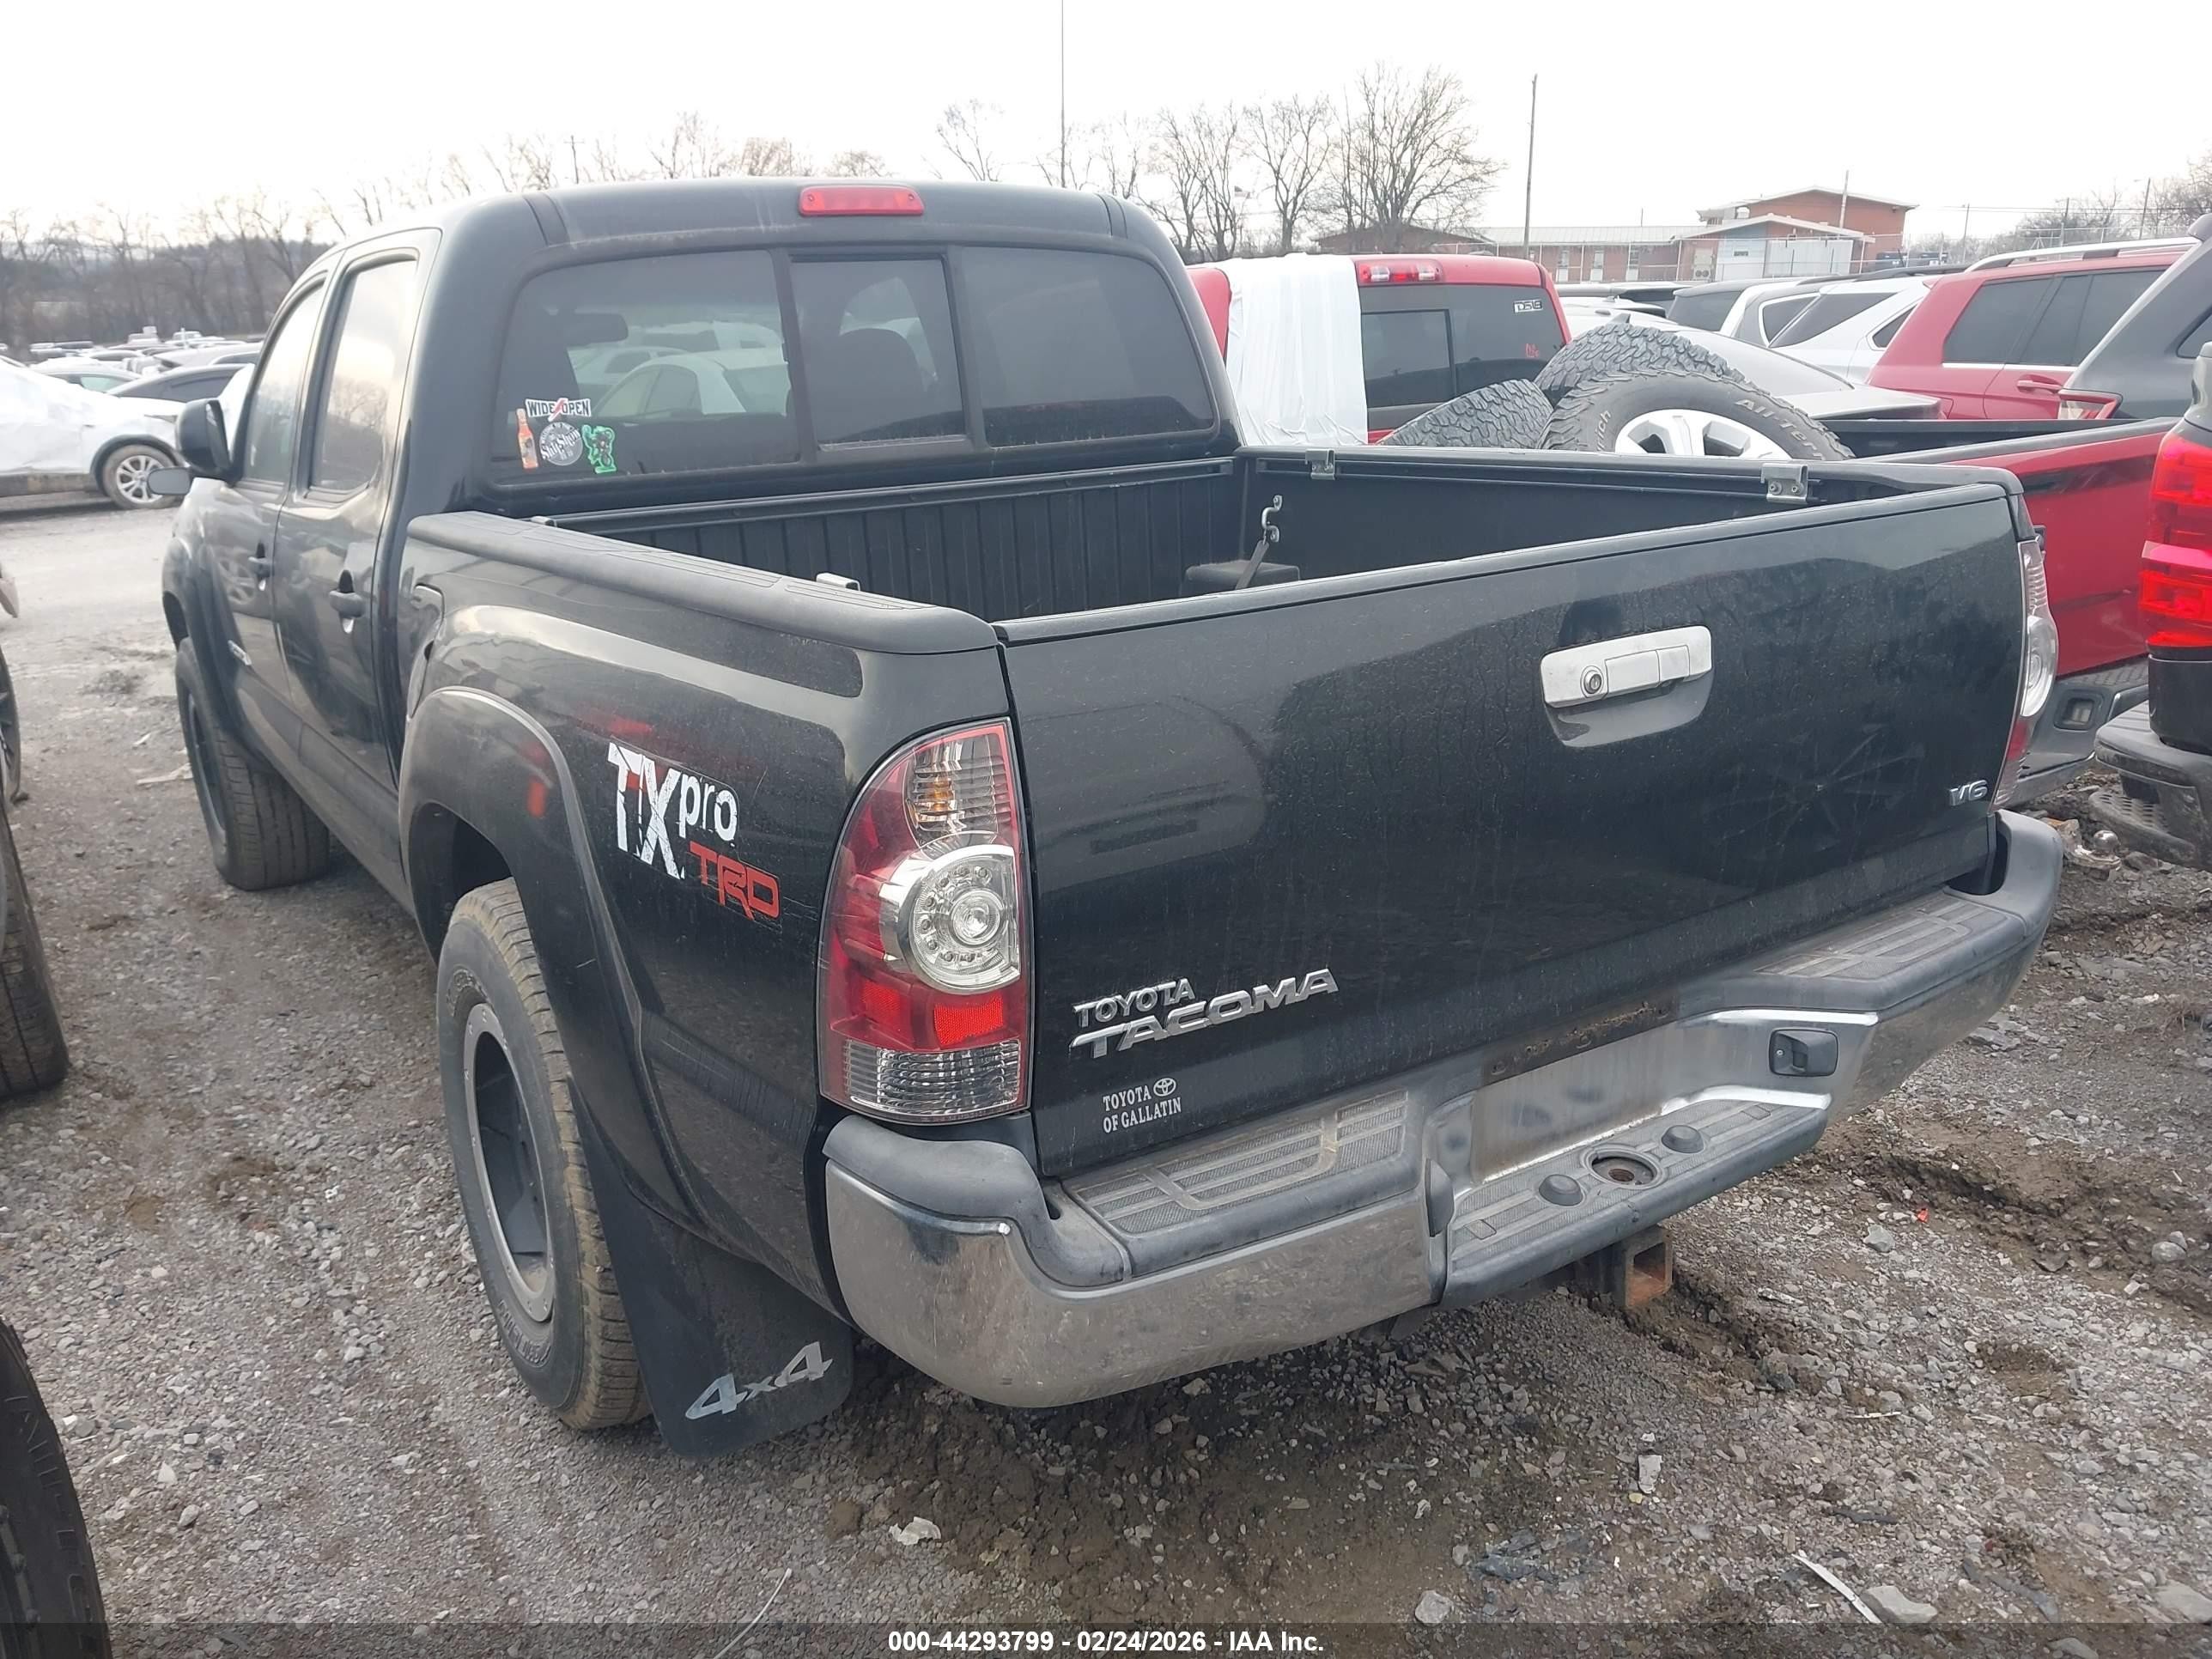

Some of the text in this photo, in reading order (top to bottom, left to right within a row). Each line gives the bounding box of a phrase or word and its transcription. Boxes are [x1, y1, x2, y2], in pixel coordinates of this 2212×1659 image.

[527, 400, 591, 416] WIDE OPEN
[1949, 779, 1988, 806] V6
[690, 840, 780, 921] TRD
[1069, 968, 1339, 1059] TACOMA
[1073, 977, 1196, 1028] TOYOTA
[1103, 1085, 1152, 1112] TOYOTA
[1103, 1097, 1182, 1134] OF GALLATIN
[684, 1341, 834, 1420] 4x4
